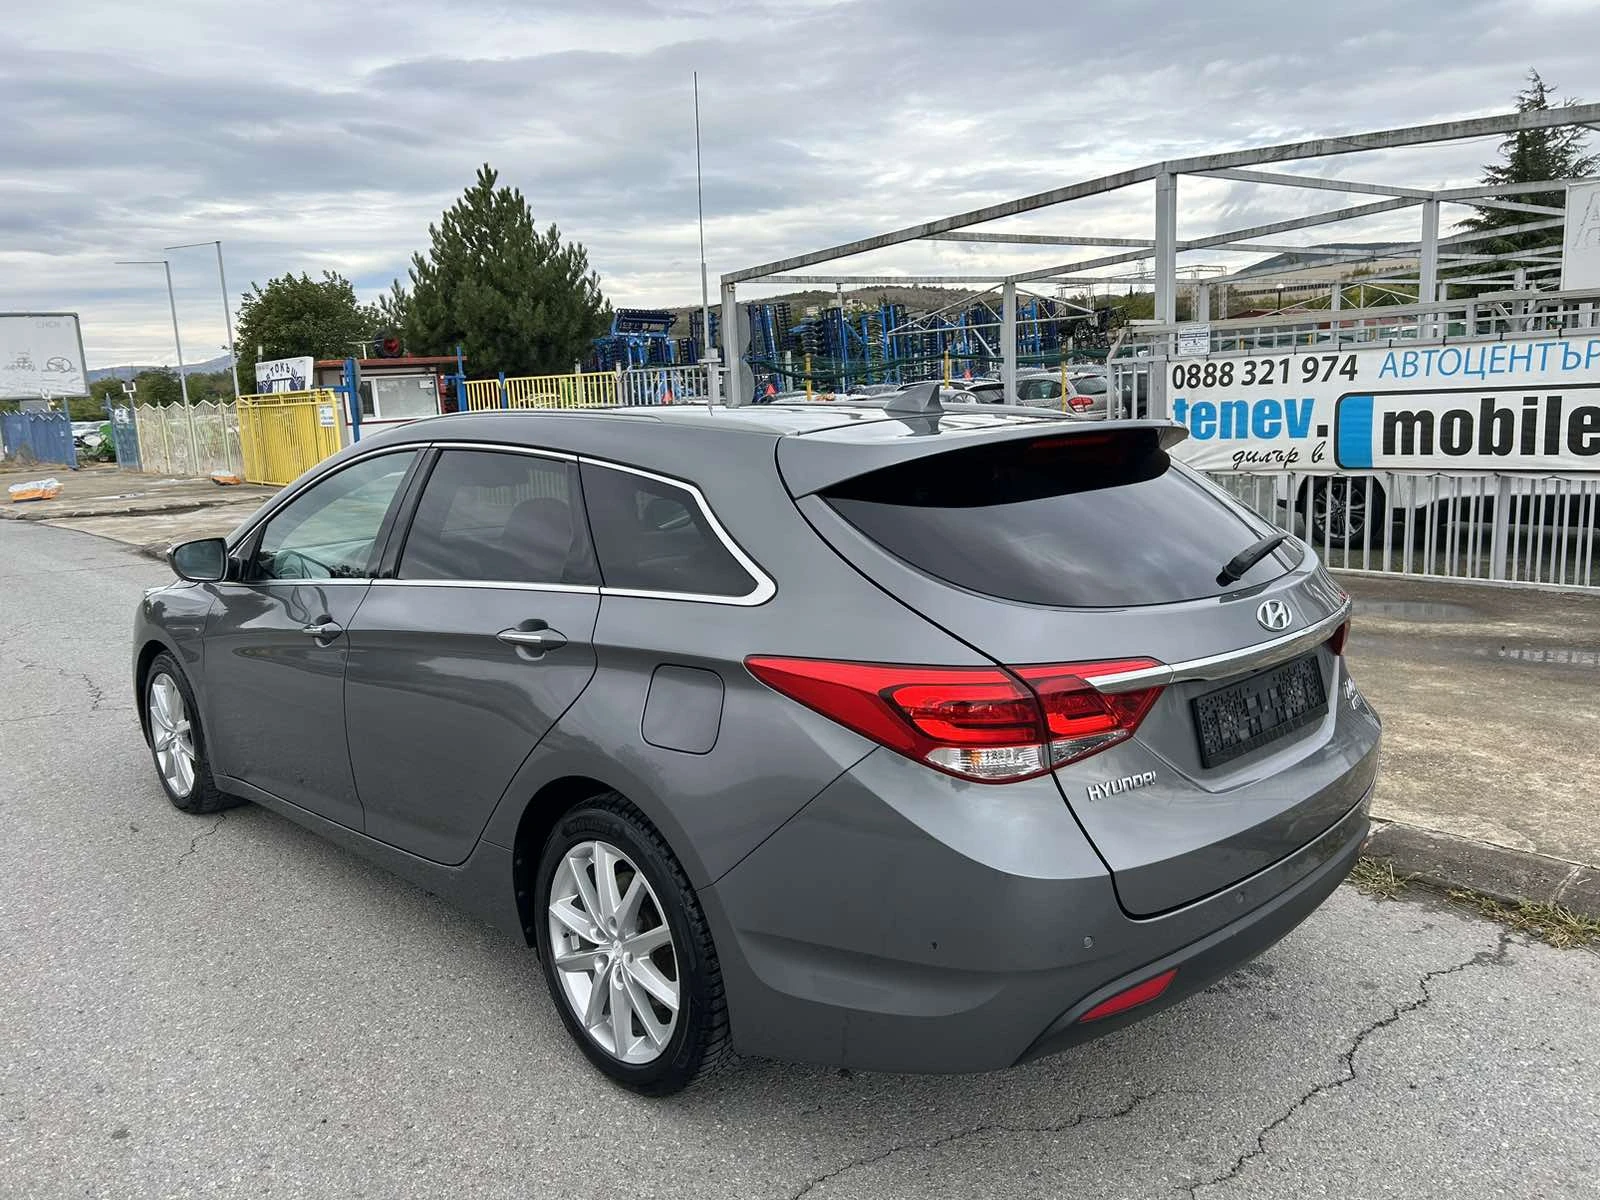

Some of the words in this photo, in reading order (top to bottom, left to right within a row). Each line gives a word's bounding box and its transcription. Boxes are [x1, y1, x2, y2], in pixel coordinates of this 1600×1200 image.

[1172, 361, 1234, 389] 0888
[1241, 358, 1290, 386] 321
[1302, 354, 1358, 383] 974
[1378, 339, 1600, 380] АВТОЦЕНТЪР
[1383, 395, 1600, 456] mobile
[1232, 447, 1300, 470] дилър
[1311, 440, 1327, 464] в
[1086, 770, 1157, 801] HYUNDAI
